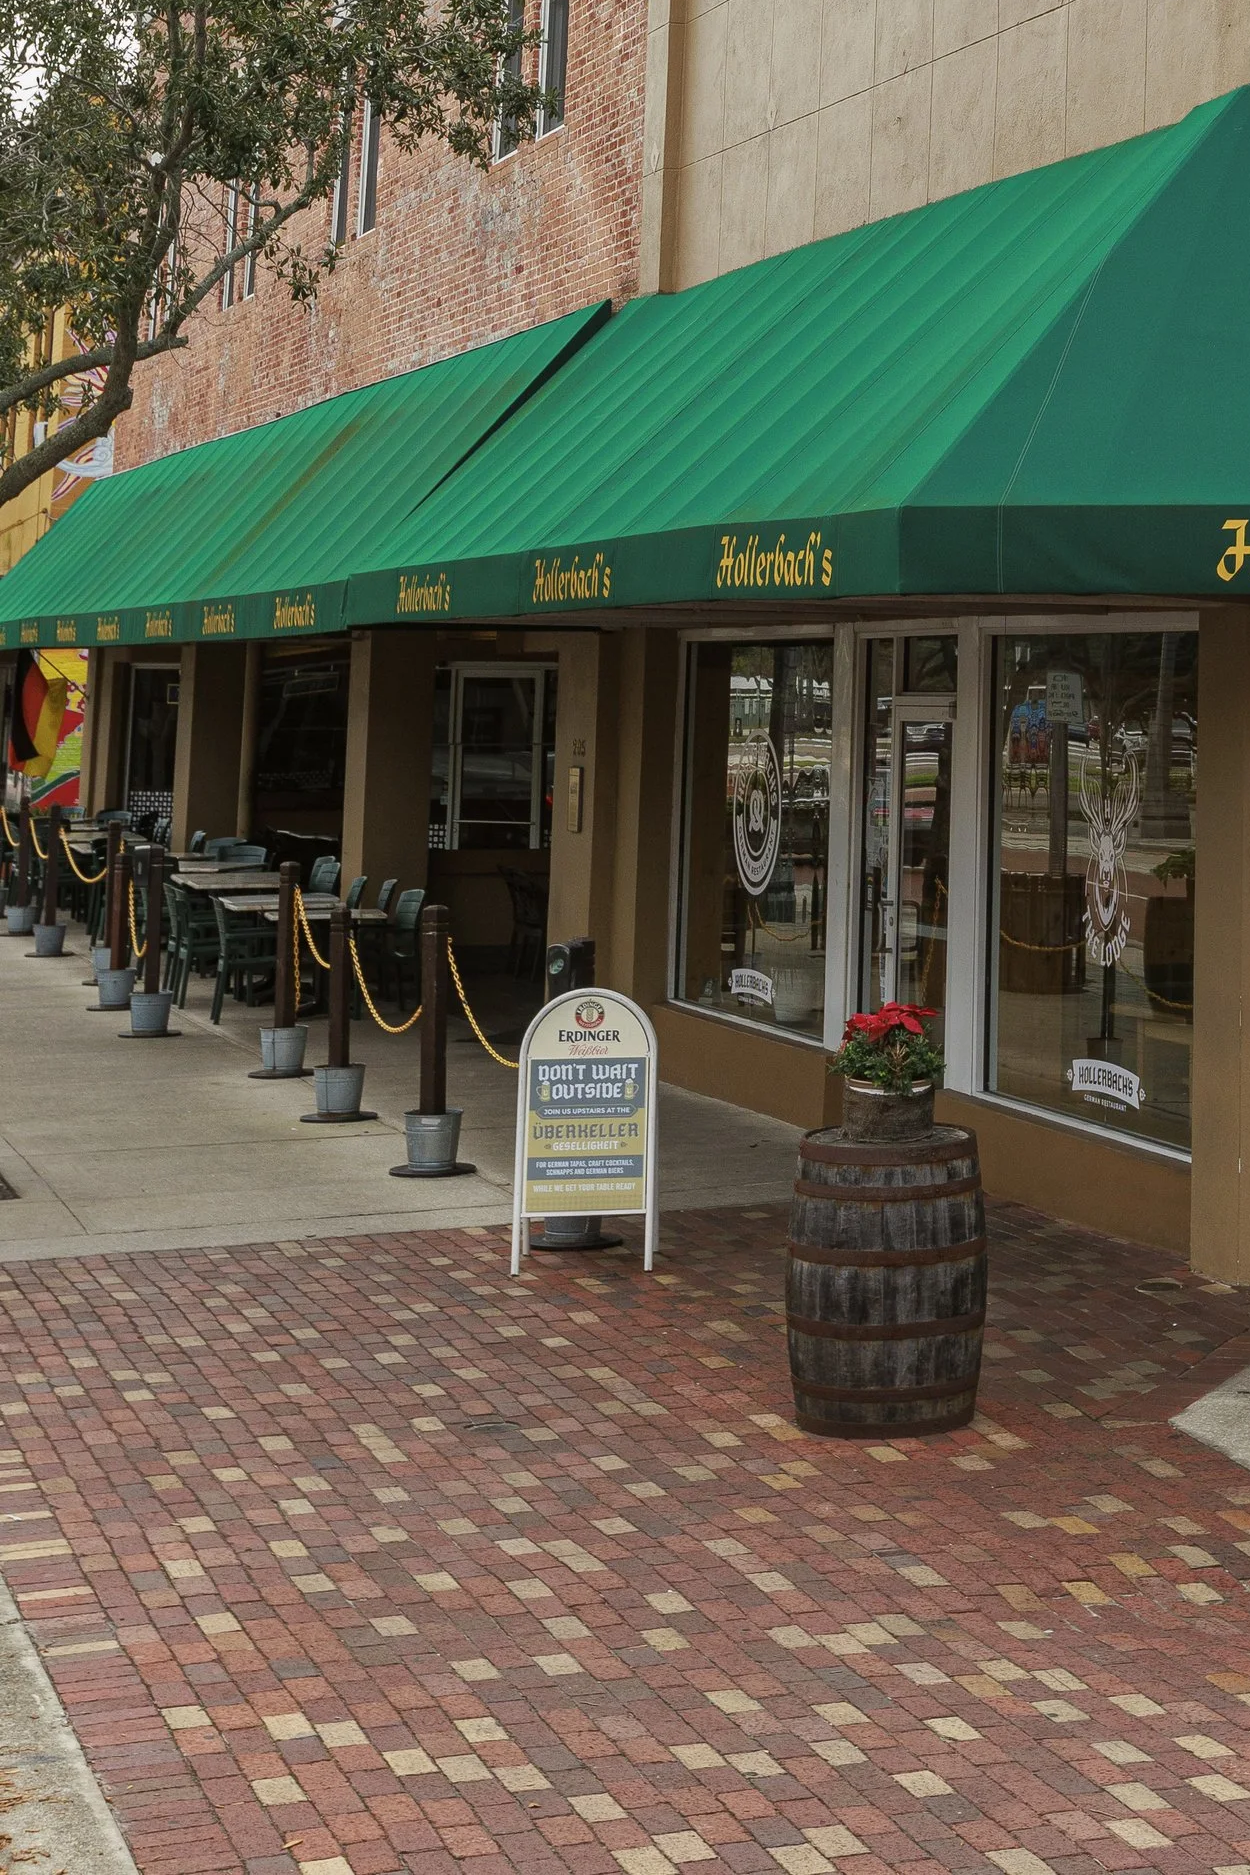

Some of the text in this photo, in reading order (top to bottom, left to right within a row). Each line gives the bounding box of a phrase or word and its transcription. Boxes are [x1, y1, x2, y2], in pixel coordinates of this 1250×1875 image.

[716, 531, 833, 588] Hollerbach's
[532, 552, 611, 604] Hollerbach's
[396, 572, 451, 614] Hollerbach's
[1081, 904, 1131, 968] THE LODGE
[558, 1029, 621, 1043] ERDINGER
[568, 1044, 609, 1057] Weißbier
[538, 1063, 639, 1081] DON'T WAIT
[1078, 1066, 1134, 1097] HOLLERBACH'S
[552, 1082, 623, 1100] OUTSIDE
[543, 1108, 560, 1116] JOIN
[572, 1107, 606, 1115] UPSTAIRS
[546, 1168, 574, 1176] SCHNAPPS
[585, 1167, 607, 1175] GERMAN
[569, 1160, 587, 1168] TAPAS,
[588, 1159, 604, 1167] CRAFT
[605, 1159, 635, 1167] COCKTAILS,
[533, 1182, 636, 1193] WHILE WE GET YOUR TABLE READY
